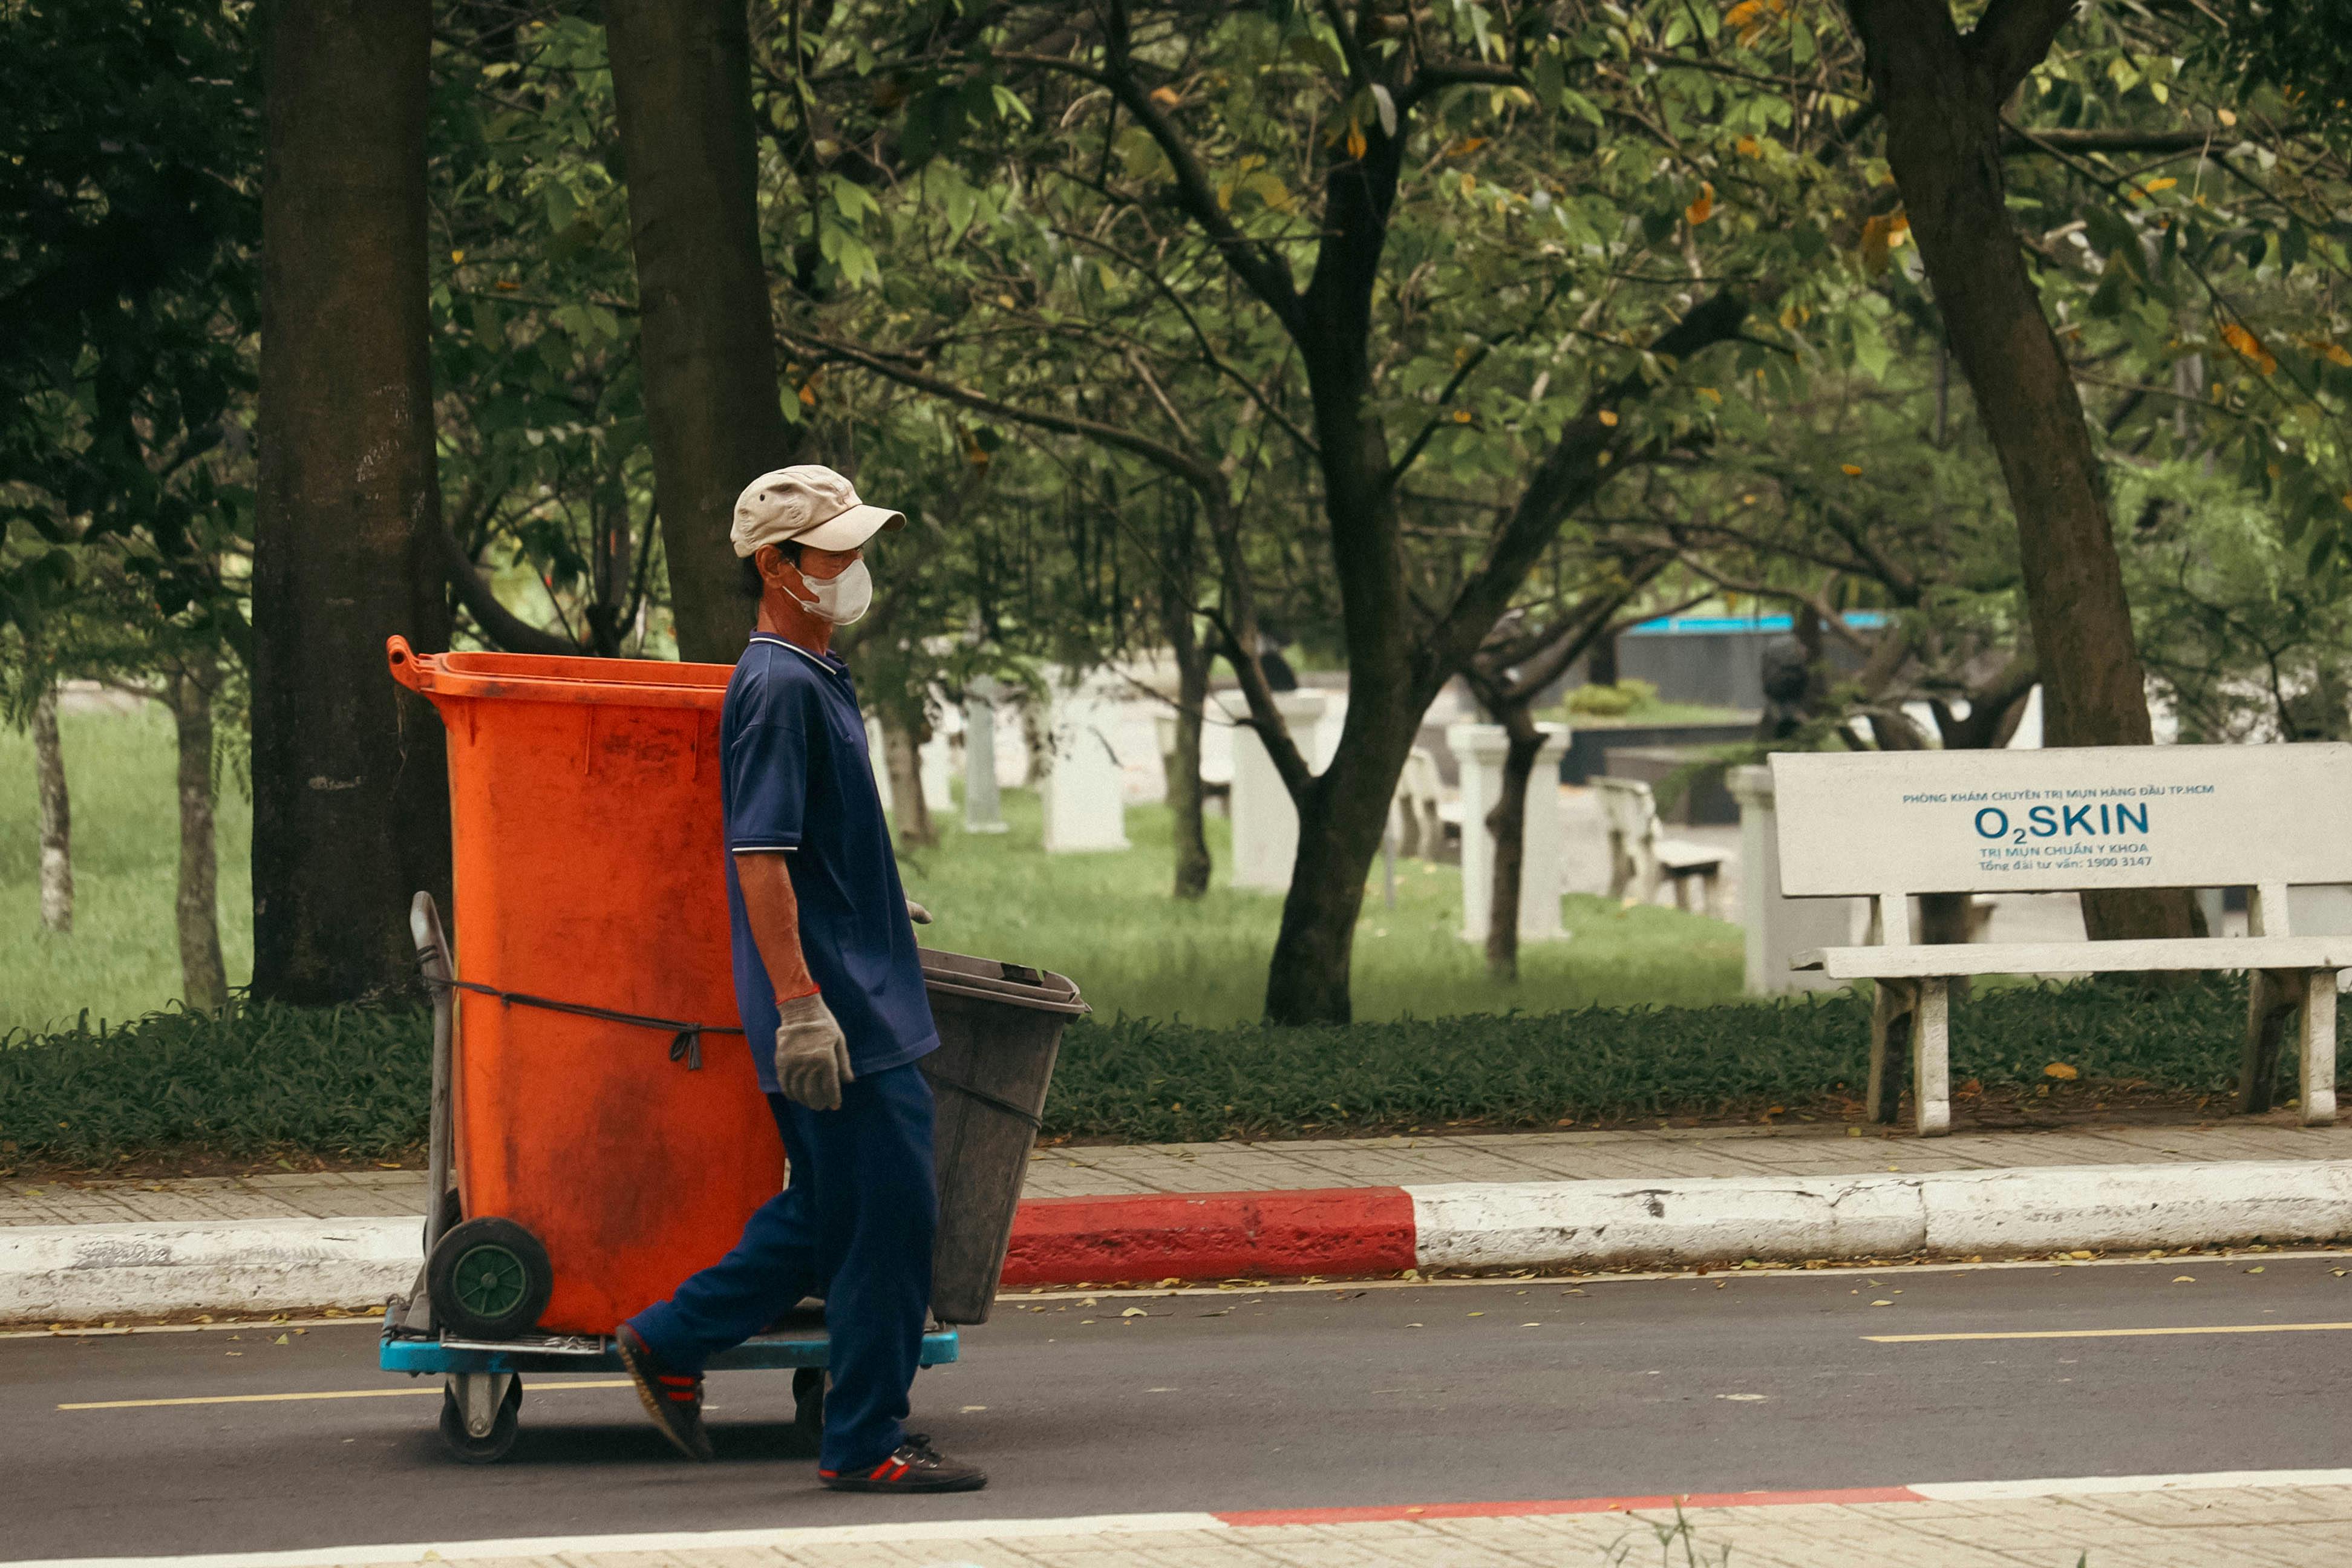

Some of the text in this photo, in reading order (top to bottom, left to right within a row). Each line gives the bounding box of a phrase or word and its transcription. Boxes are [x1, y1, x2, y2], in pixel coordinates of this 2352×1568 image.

[1903, 792, 1947, 803] PHÒNG
[1950, 791, 1988, 802] KHÁM
[1991, 789, 2040, 800] CHUYÊN
[2100, 786, 2136, 797] HÀNG
[1980, 848, 2001, 858] TRỊ
[2005, 847, 2040, 858] MỤN
[2097, 844, 2105, 853] Y
[2109, 843, 2149, 854] KHOA
[2086, 858, 2118, 867] 1900
[2121, 856, 2152, 866] 3147
